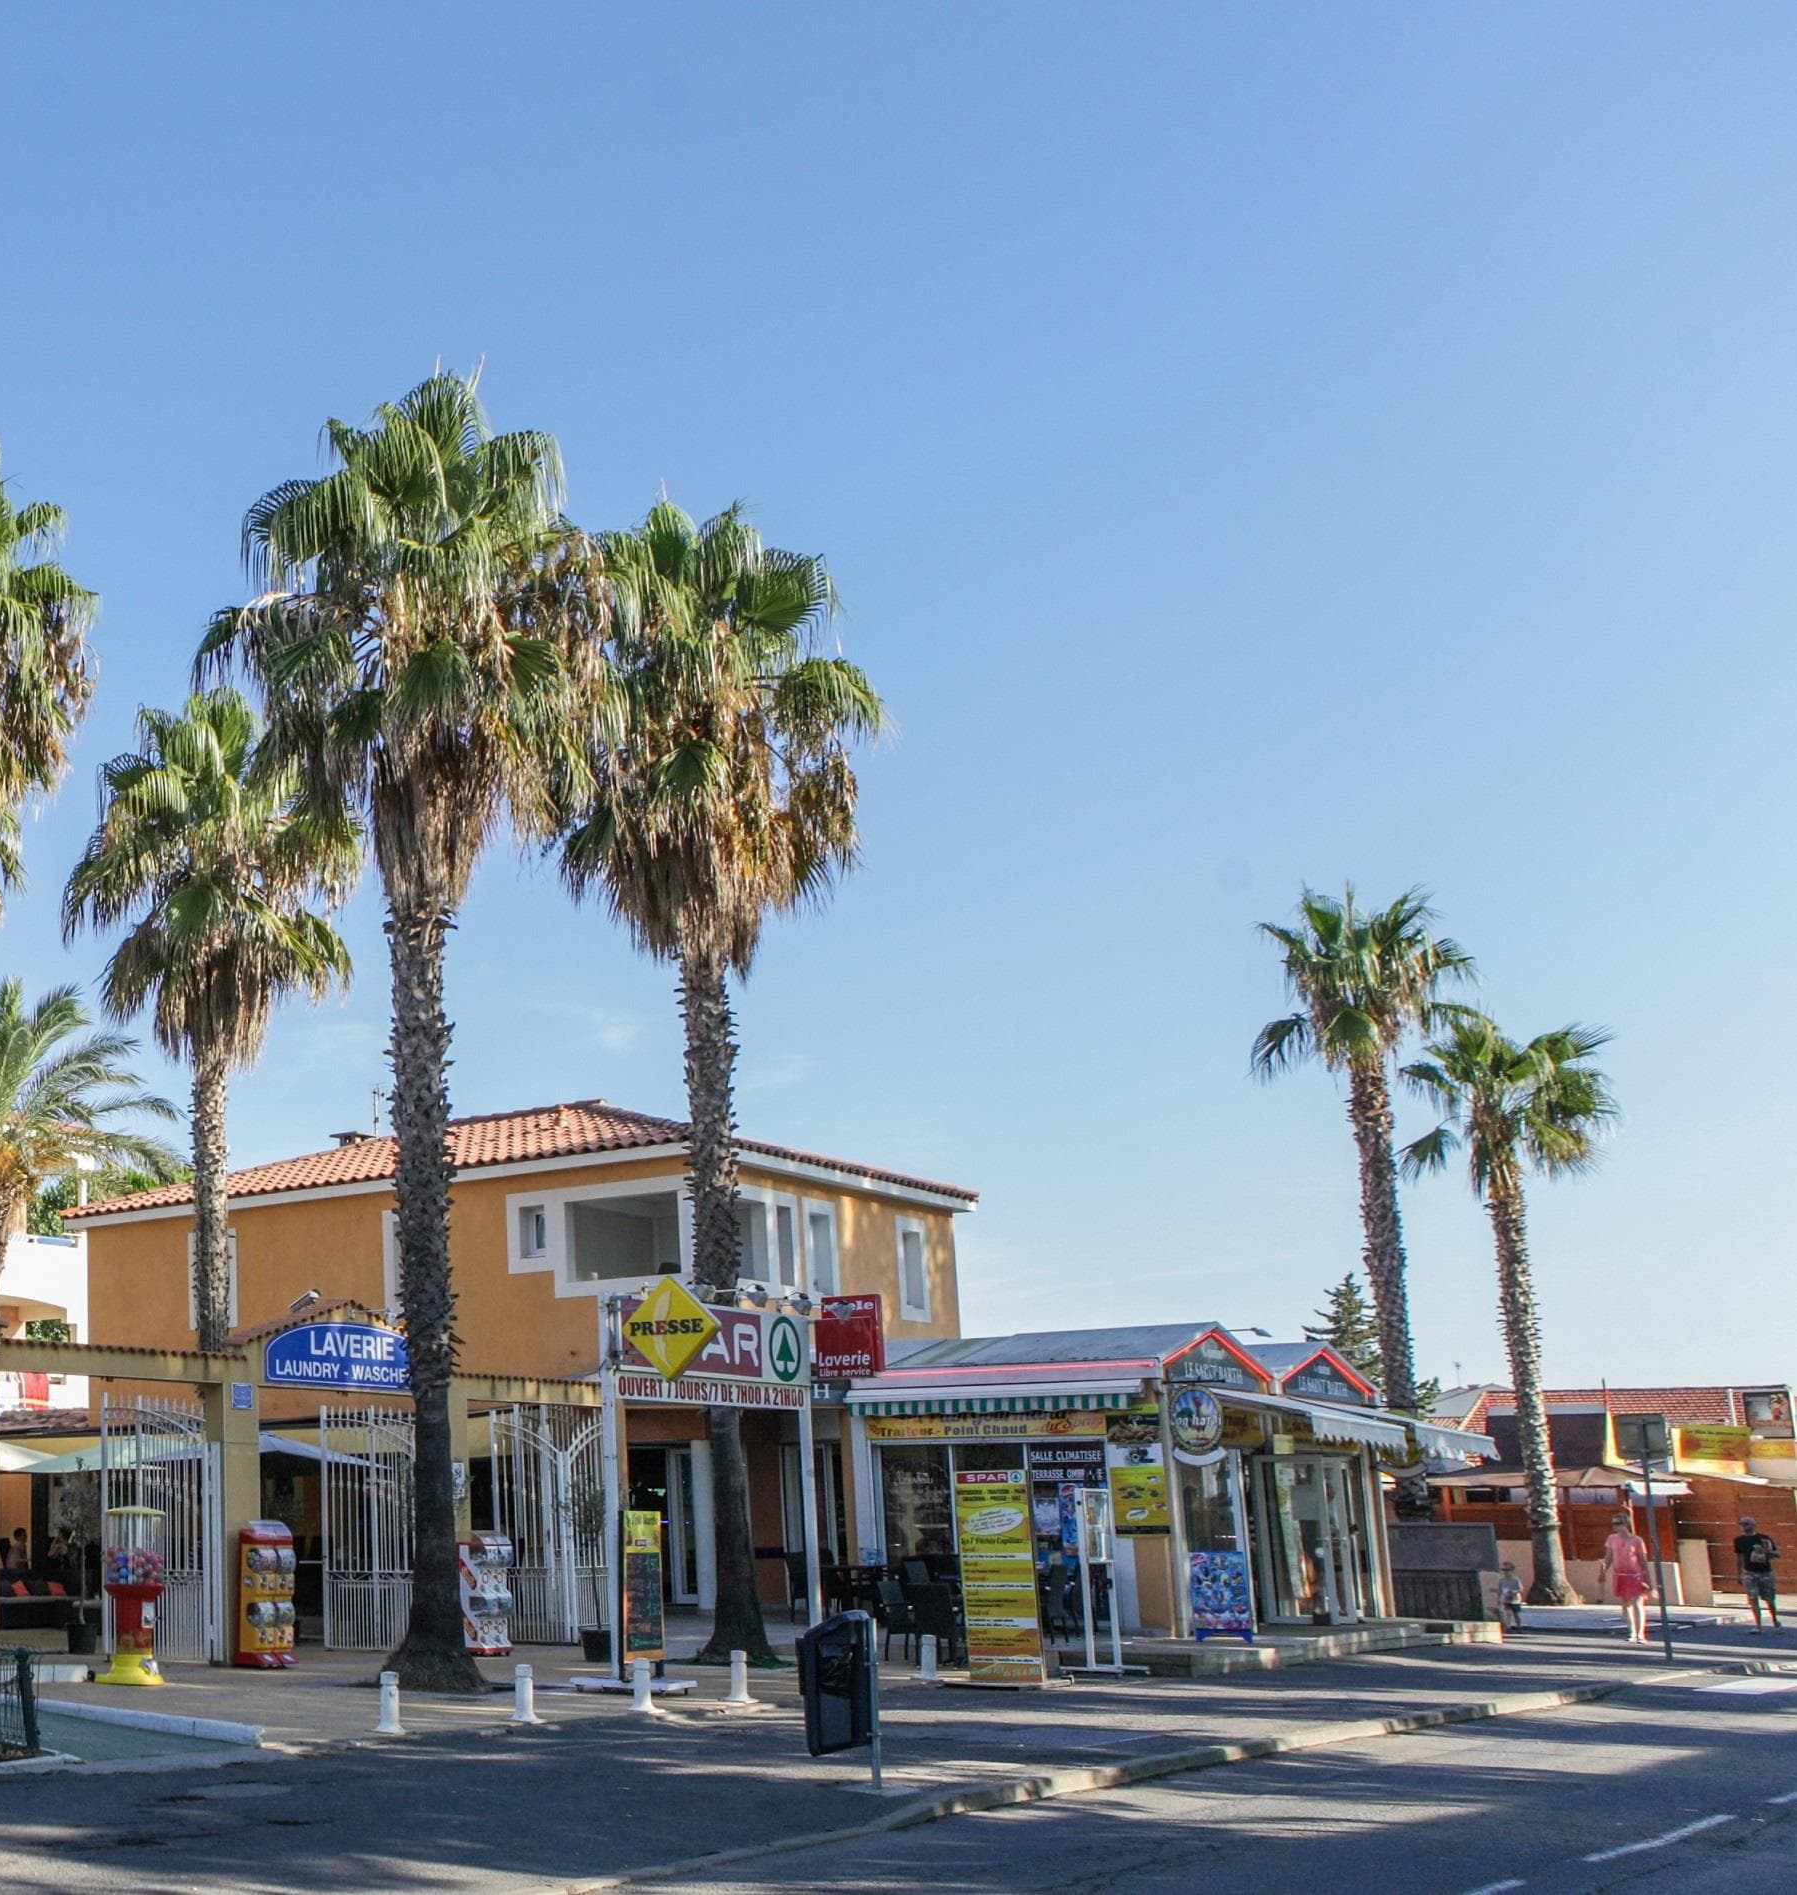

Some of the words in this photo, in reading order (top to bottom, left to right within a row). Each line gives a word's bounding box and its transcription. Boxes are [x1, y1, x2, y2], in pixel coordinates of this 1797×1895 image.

[629, 1318, 703, 1336] PRESSE
[310, 1330, 395, 1361] LAVERIE
[818, 1350, 871, 1367] Laverie
[275, 1359, 341, 1379] LAUNDRY
[351, 1364, 411, 1383] WASCHE
[819, 1368, 838, 1377] Libre
[842, 1367, 870, 1376] service
[618, 1375, 664, 1398] OUVERT
[666, 1381, 672, 1398] 7
[674, 1380, 719, 1402] JOURS/7
[721, 1384, 734, 1403] DE
[736, 1385, 761, 1404] 7H00
[763, 1387, 771, 1405] A
[772, 1387, 804, 1407] 21H00
[944, 1425, 979, 1435] Point
[983, 1424, 1027, 1435] Chaud
[1030, 1451, 1053, 1461] SALLE
[1055, 1450, 1102, 1460] CLIMATISEE
[966, 1474, 1007, 1483] SPAR
[1031, 1470, 1064, 1479] TERRASSE
